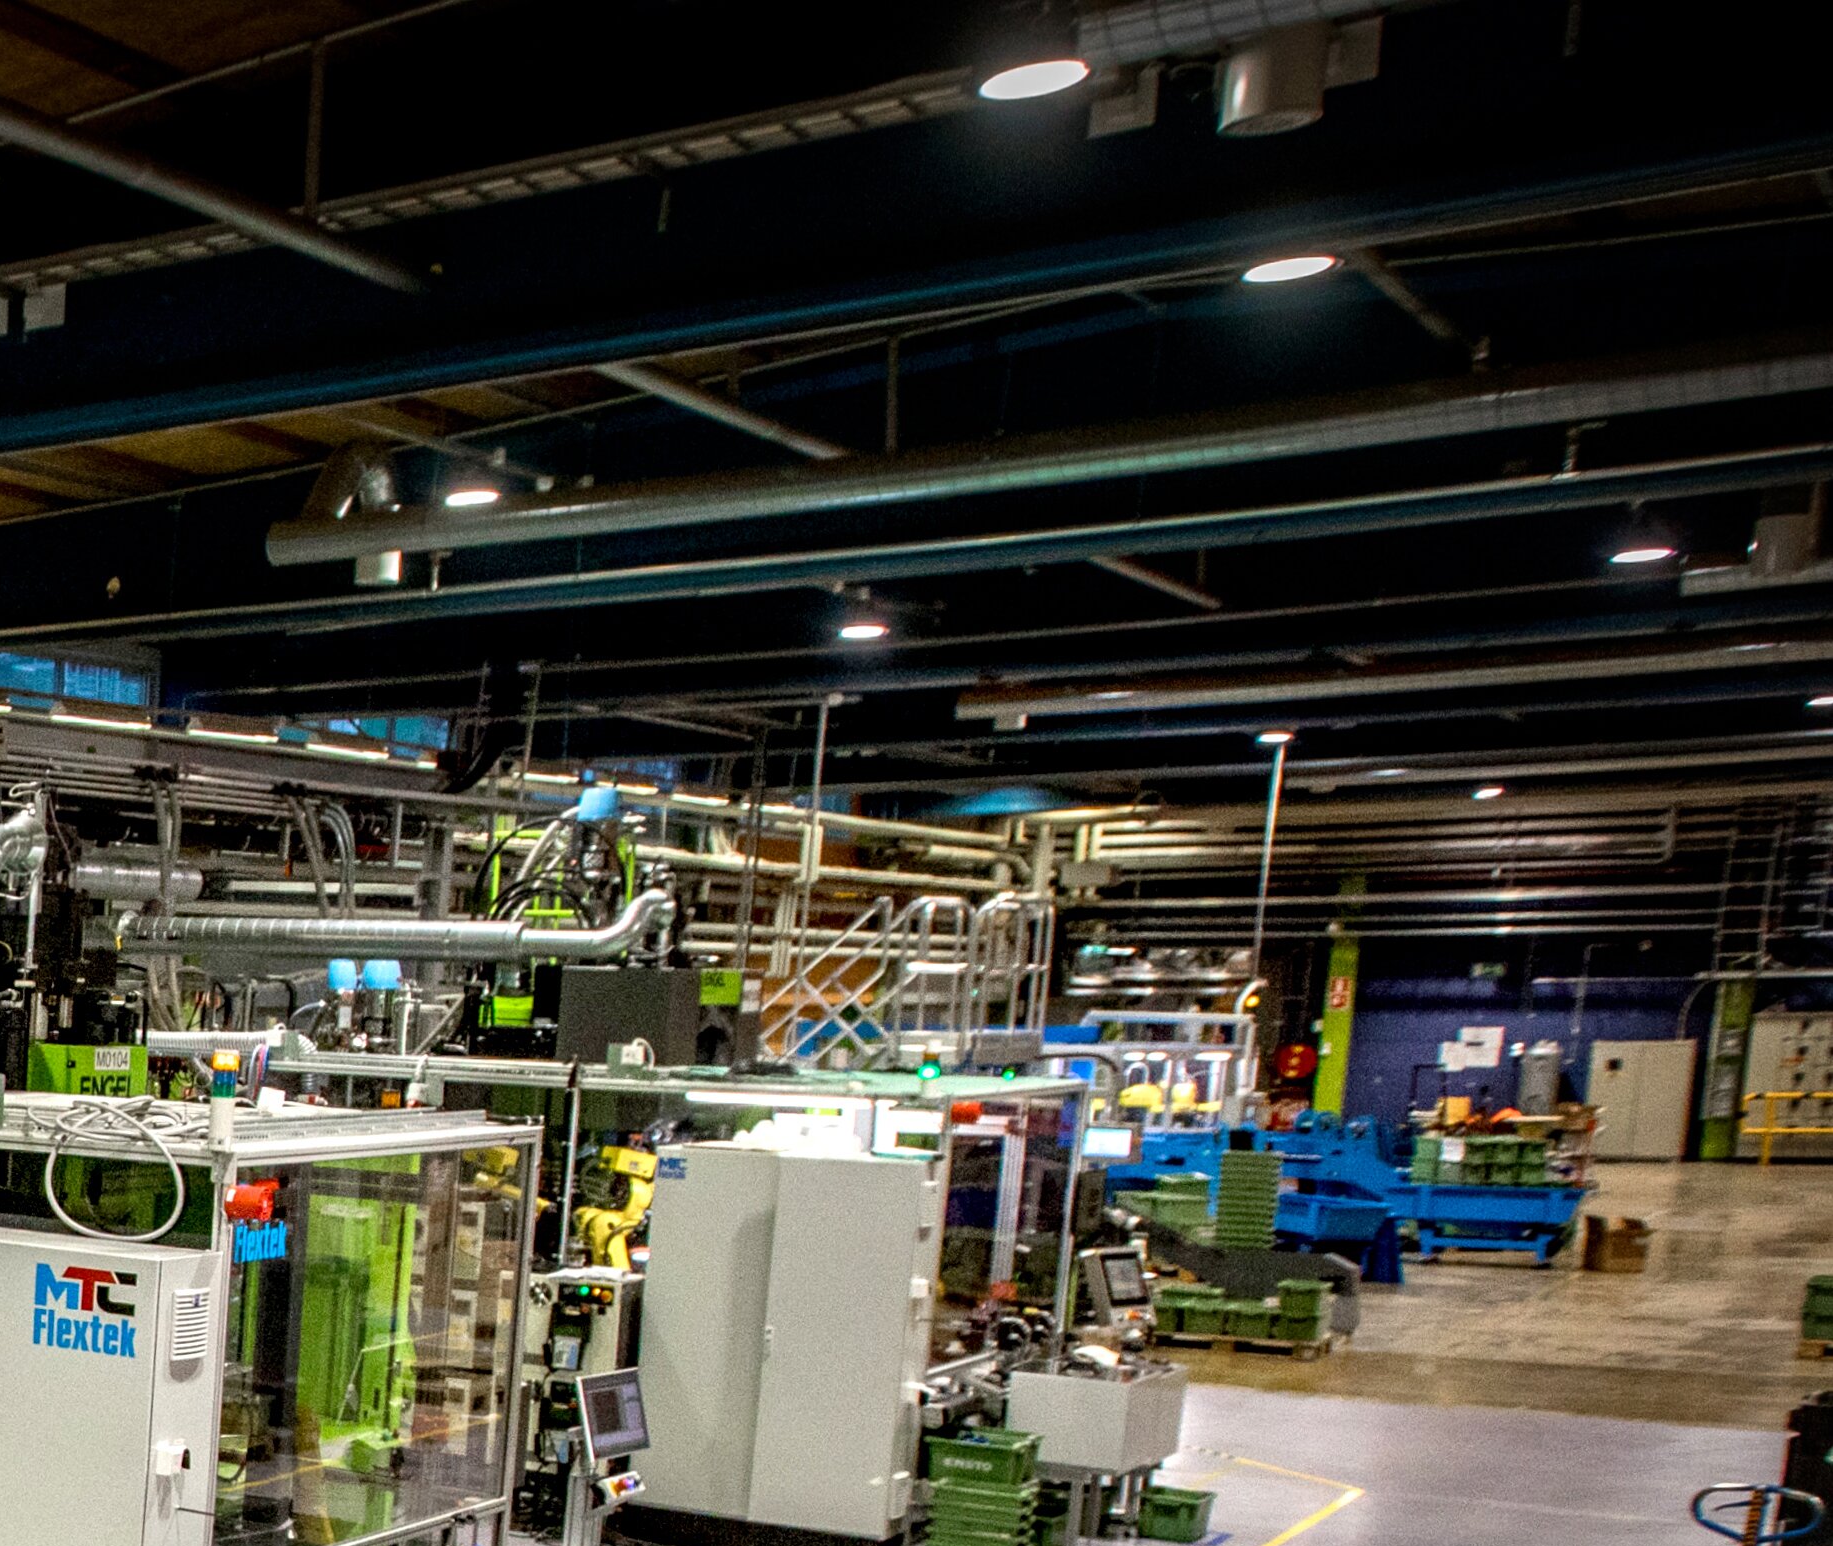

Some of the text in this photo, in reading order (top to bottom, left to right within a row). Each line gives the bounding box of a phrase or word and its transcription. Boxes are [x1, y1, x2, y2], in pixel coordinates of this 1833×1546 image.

[96, 1050, 129, 1069] M0104
[34, 1263, 137, 1317] MTC
[33, 1308, 136, 1358] Flextek
